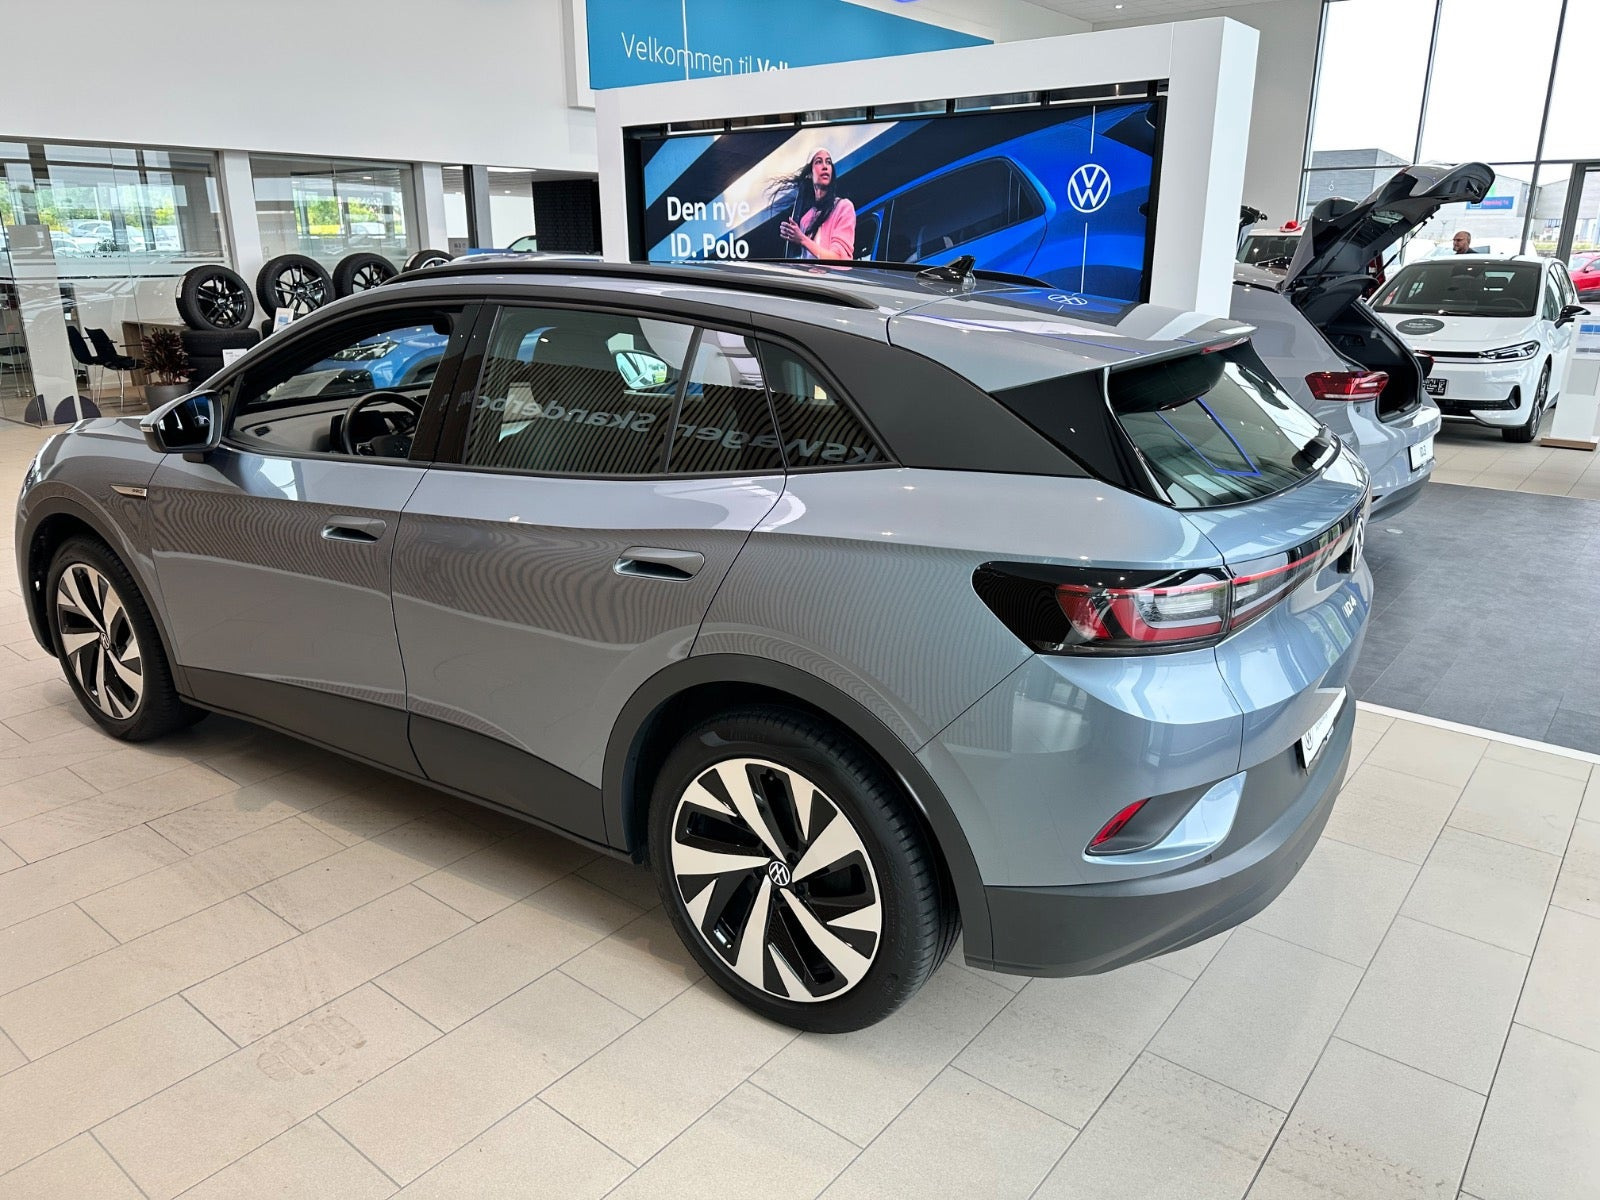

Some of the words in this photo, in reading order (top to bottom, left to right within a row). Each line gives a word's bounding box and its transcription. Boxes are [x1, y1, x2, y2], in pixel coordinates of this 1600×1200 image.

[621, 31, 732, 76] Velkommen
[738, 55, 752, 75] til
[667, 196, 706, 221] Den
[713, 200, 750, 228] nye
[671, 232, 697, 258] ID.
[703, 232, 749, 259] Polo
